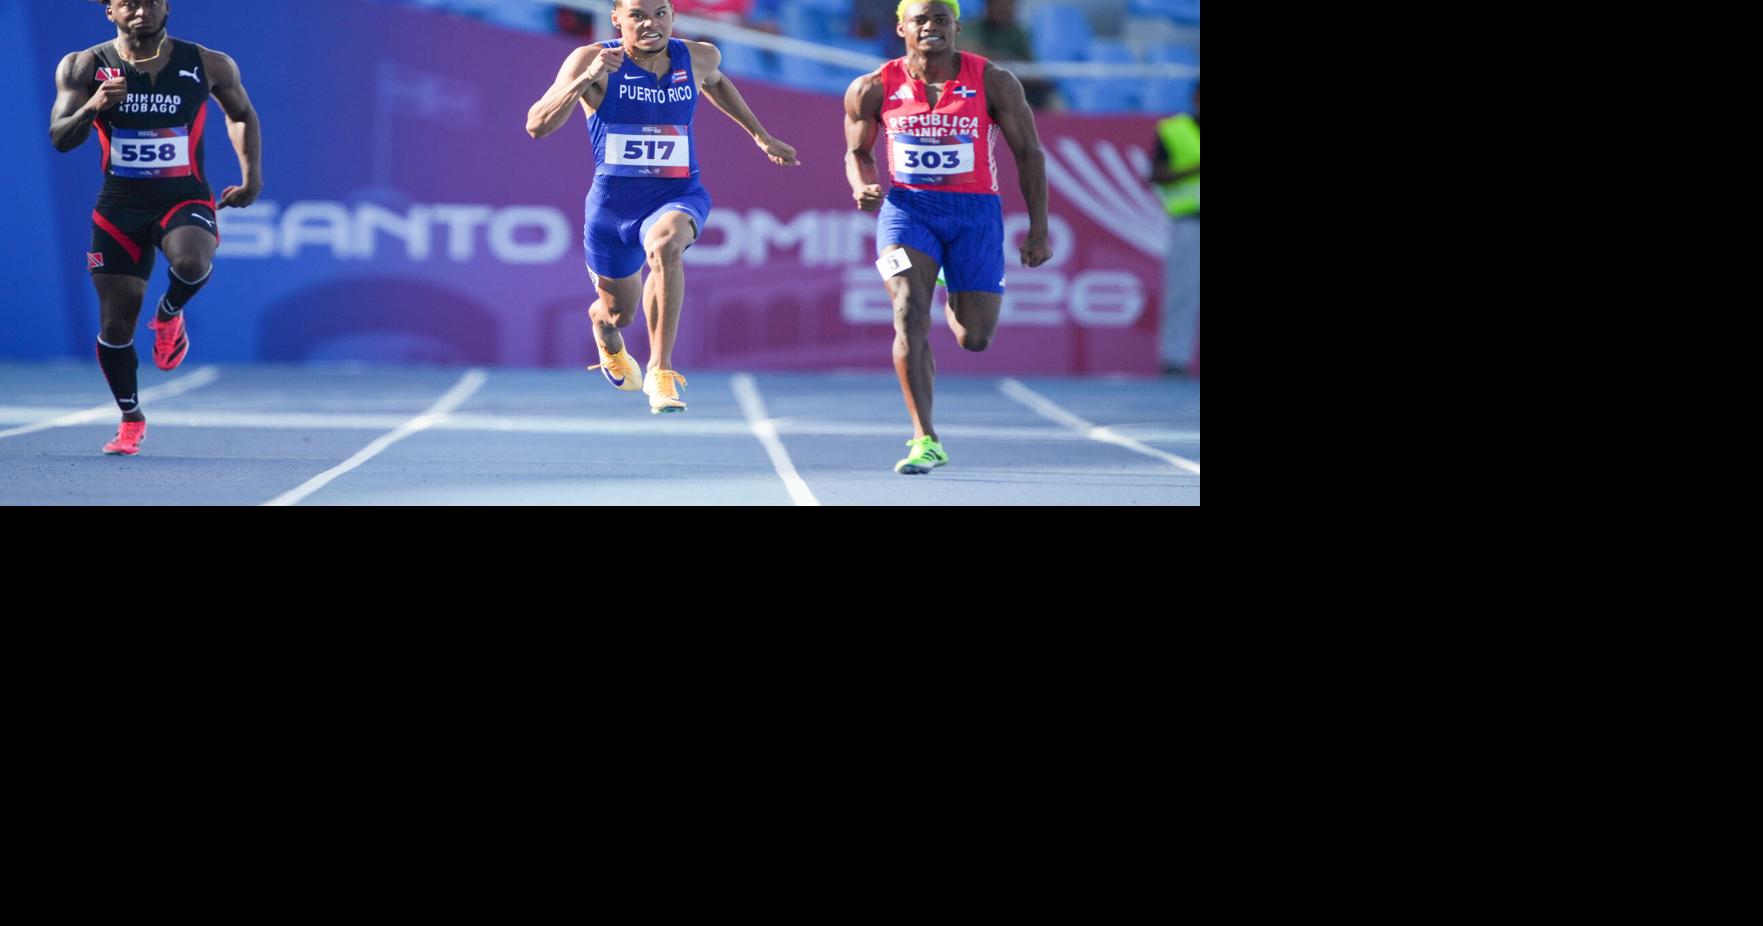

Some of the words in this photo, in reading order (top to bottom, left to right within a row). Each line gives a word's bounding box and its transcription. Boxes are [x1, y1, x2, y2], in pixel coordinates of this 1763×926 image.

[120, 93, 181, 105] RINIDAD
[620, 84, 666, 104] PUERTO
[668, 85, 692, 103] RICO
[121, 143, 176, 162] 558
[622, 140, 675, 161] 517
[904, 150, 960, 169] 303
[215, 201, 572, 264] SANTO
[887, 256, 900, 270] 5
